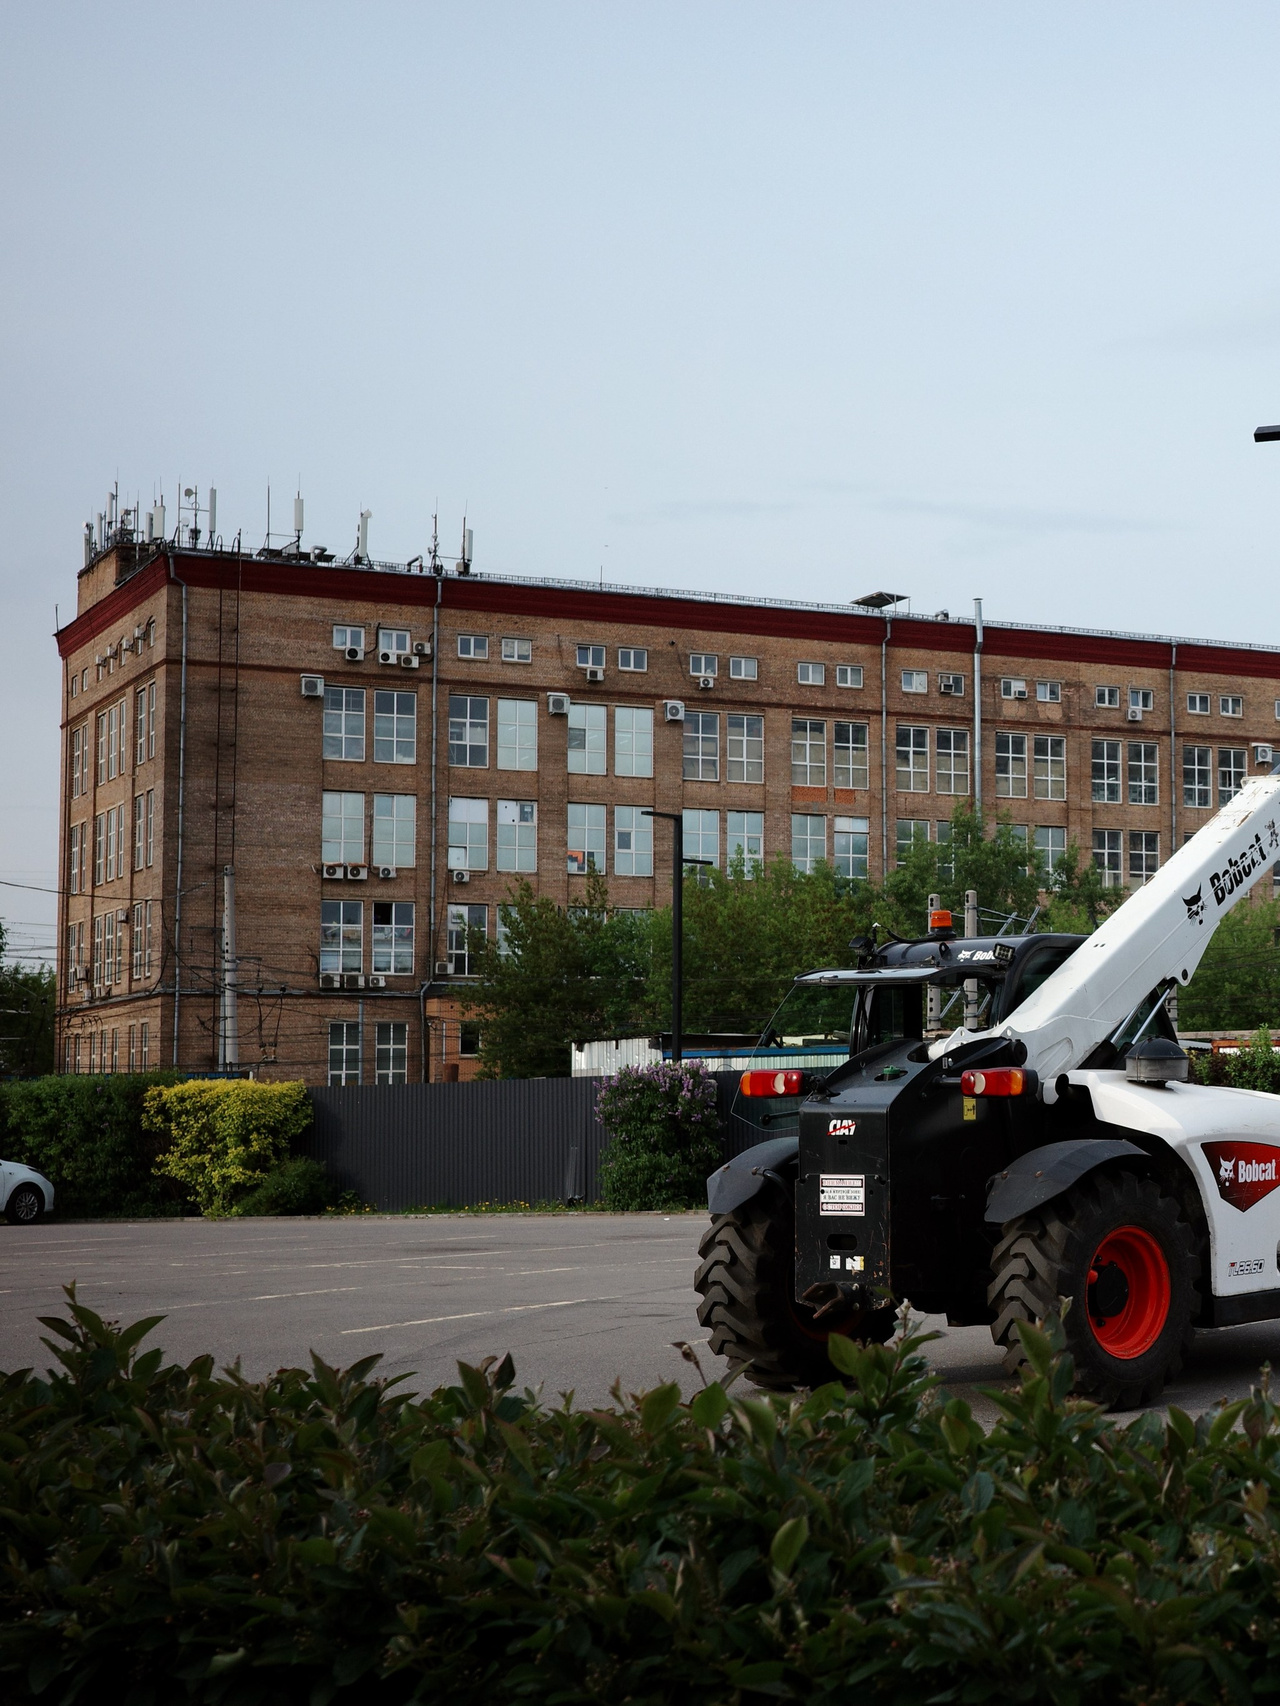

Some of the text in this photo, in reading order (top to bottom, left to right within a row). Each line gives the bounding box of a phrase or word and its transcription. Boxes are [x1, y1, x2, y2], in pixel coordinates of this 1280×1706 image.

[1209, 833, 1267, 906] Bobcat
[972, 950, 996, 961] Bob
[1238, 1158, 1276, 1183] Bobcat
